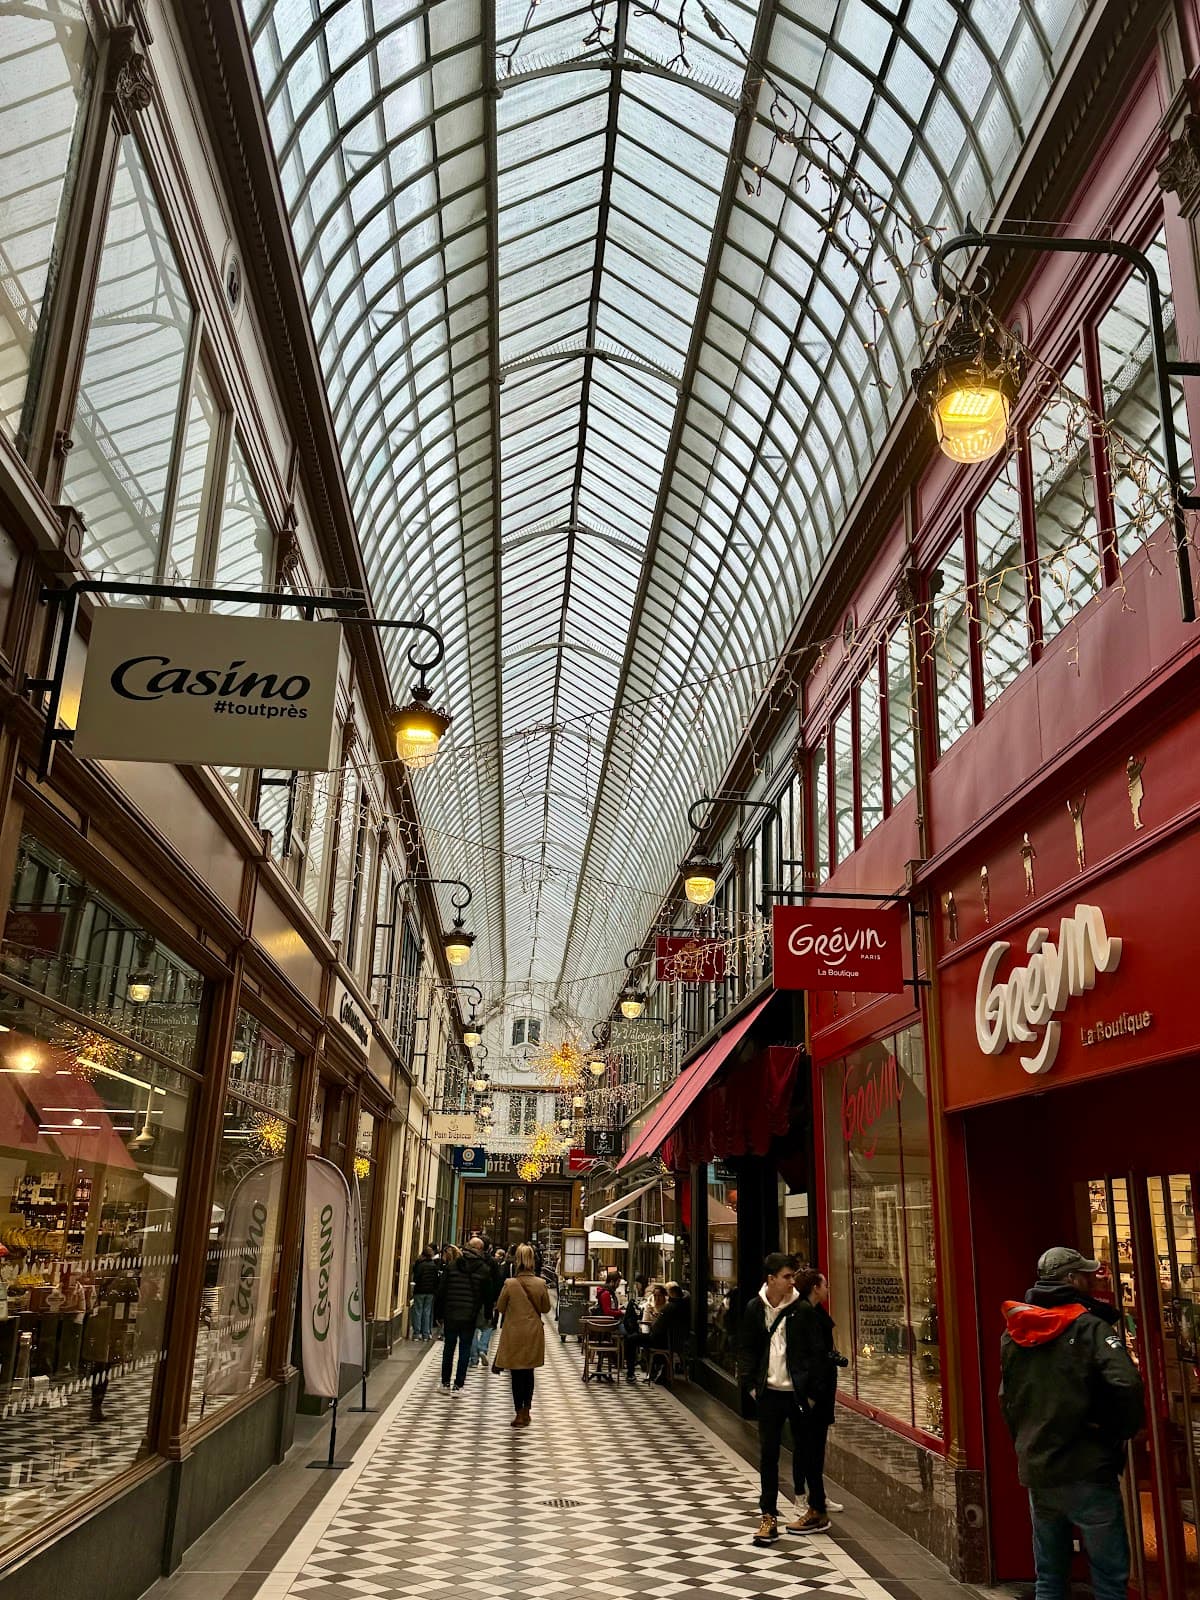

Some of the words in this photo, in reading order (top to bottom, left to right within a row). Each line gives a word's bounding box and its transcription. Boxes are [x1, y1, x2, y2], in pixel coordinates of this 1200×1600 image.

[111, 655, 311, 701] Casino
[214, 700, 308, 719] #toutprès
[817, 968, 827, 976] La
[828, 969, 860, 979] Boutique
[1080, 1027, 1094, 1046] La
[1096, 1010, 1153, 1042] Boutique
